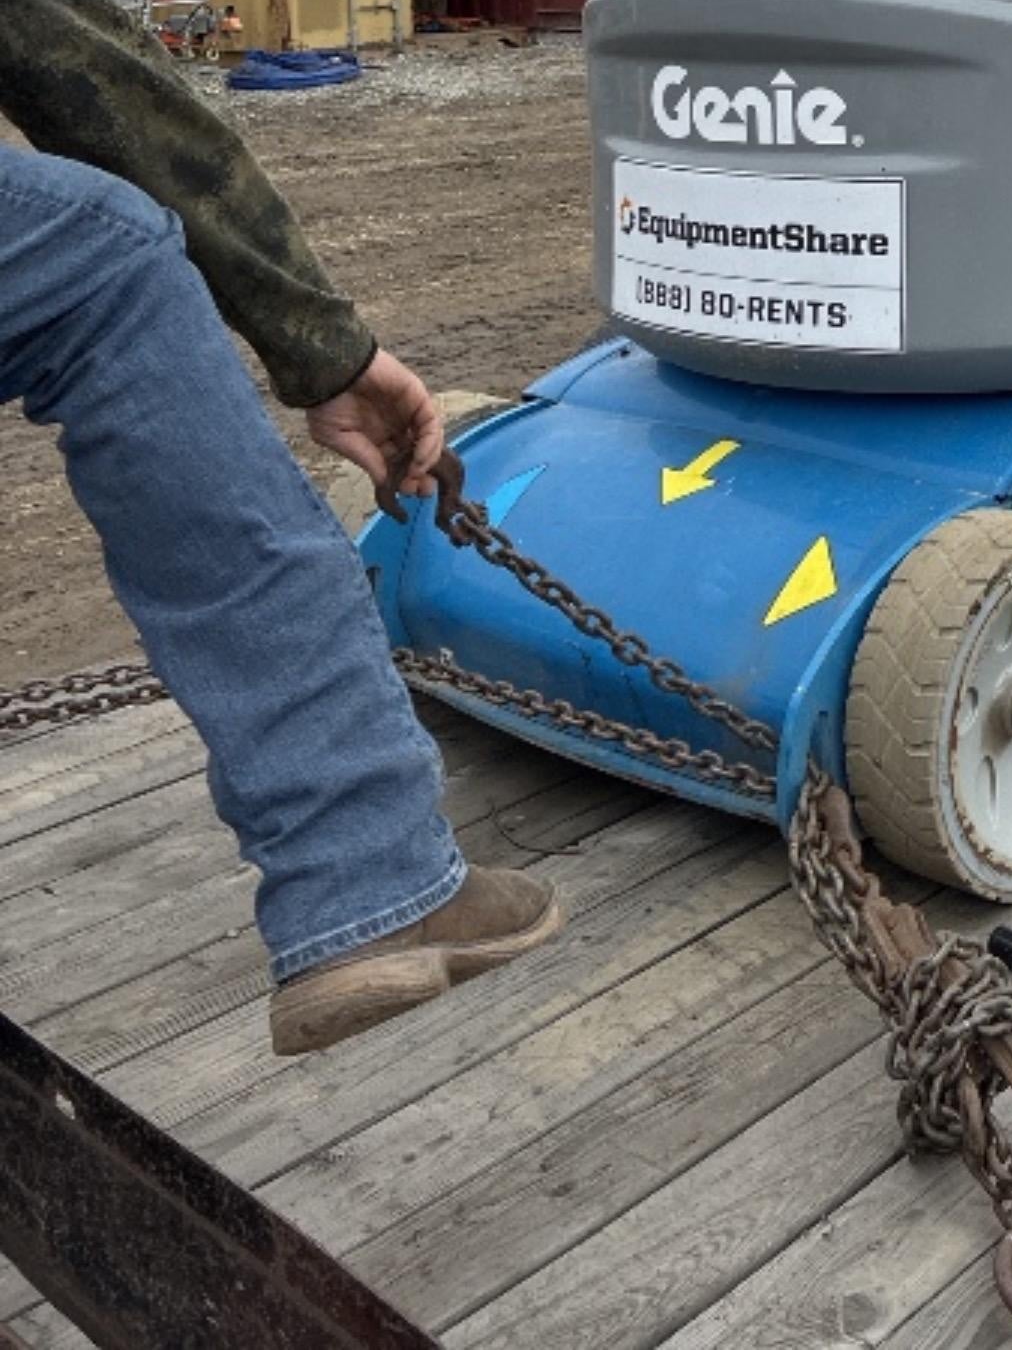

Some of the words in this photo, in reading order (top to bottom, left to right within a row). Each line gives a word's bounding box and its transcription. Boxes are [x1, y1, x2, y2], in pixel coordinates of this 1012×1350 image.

[651, 64, 847, 145] Genie
[637, 206, 889, 256] EquipmentShare
[700, 290, 847, 328] 80-RENTS
